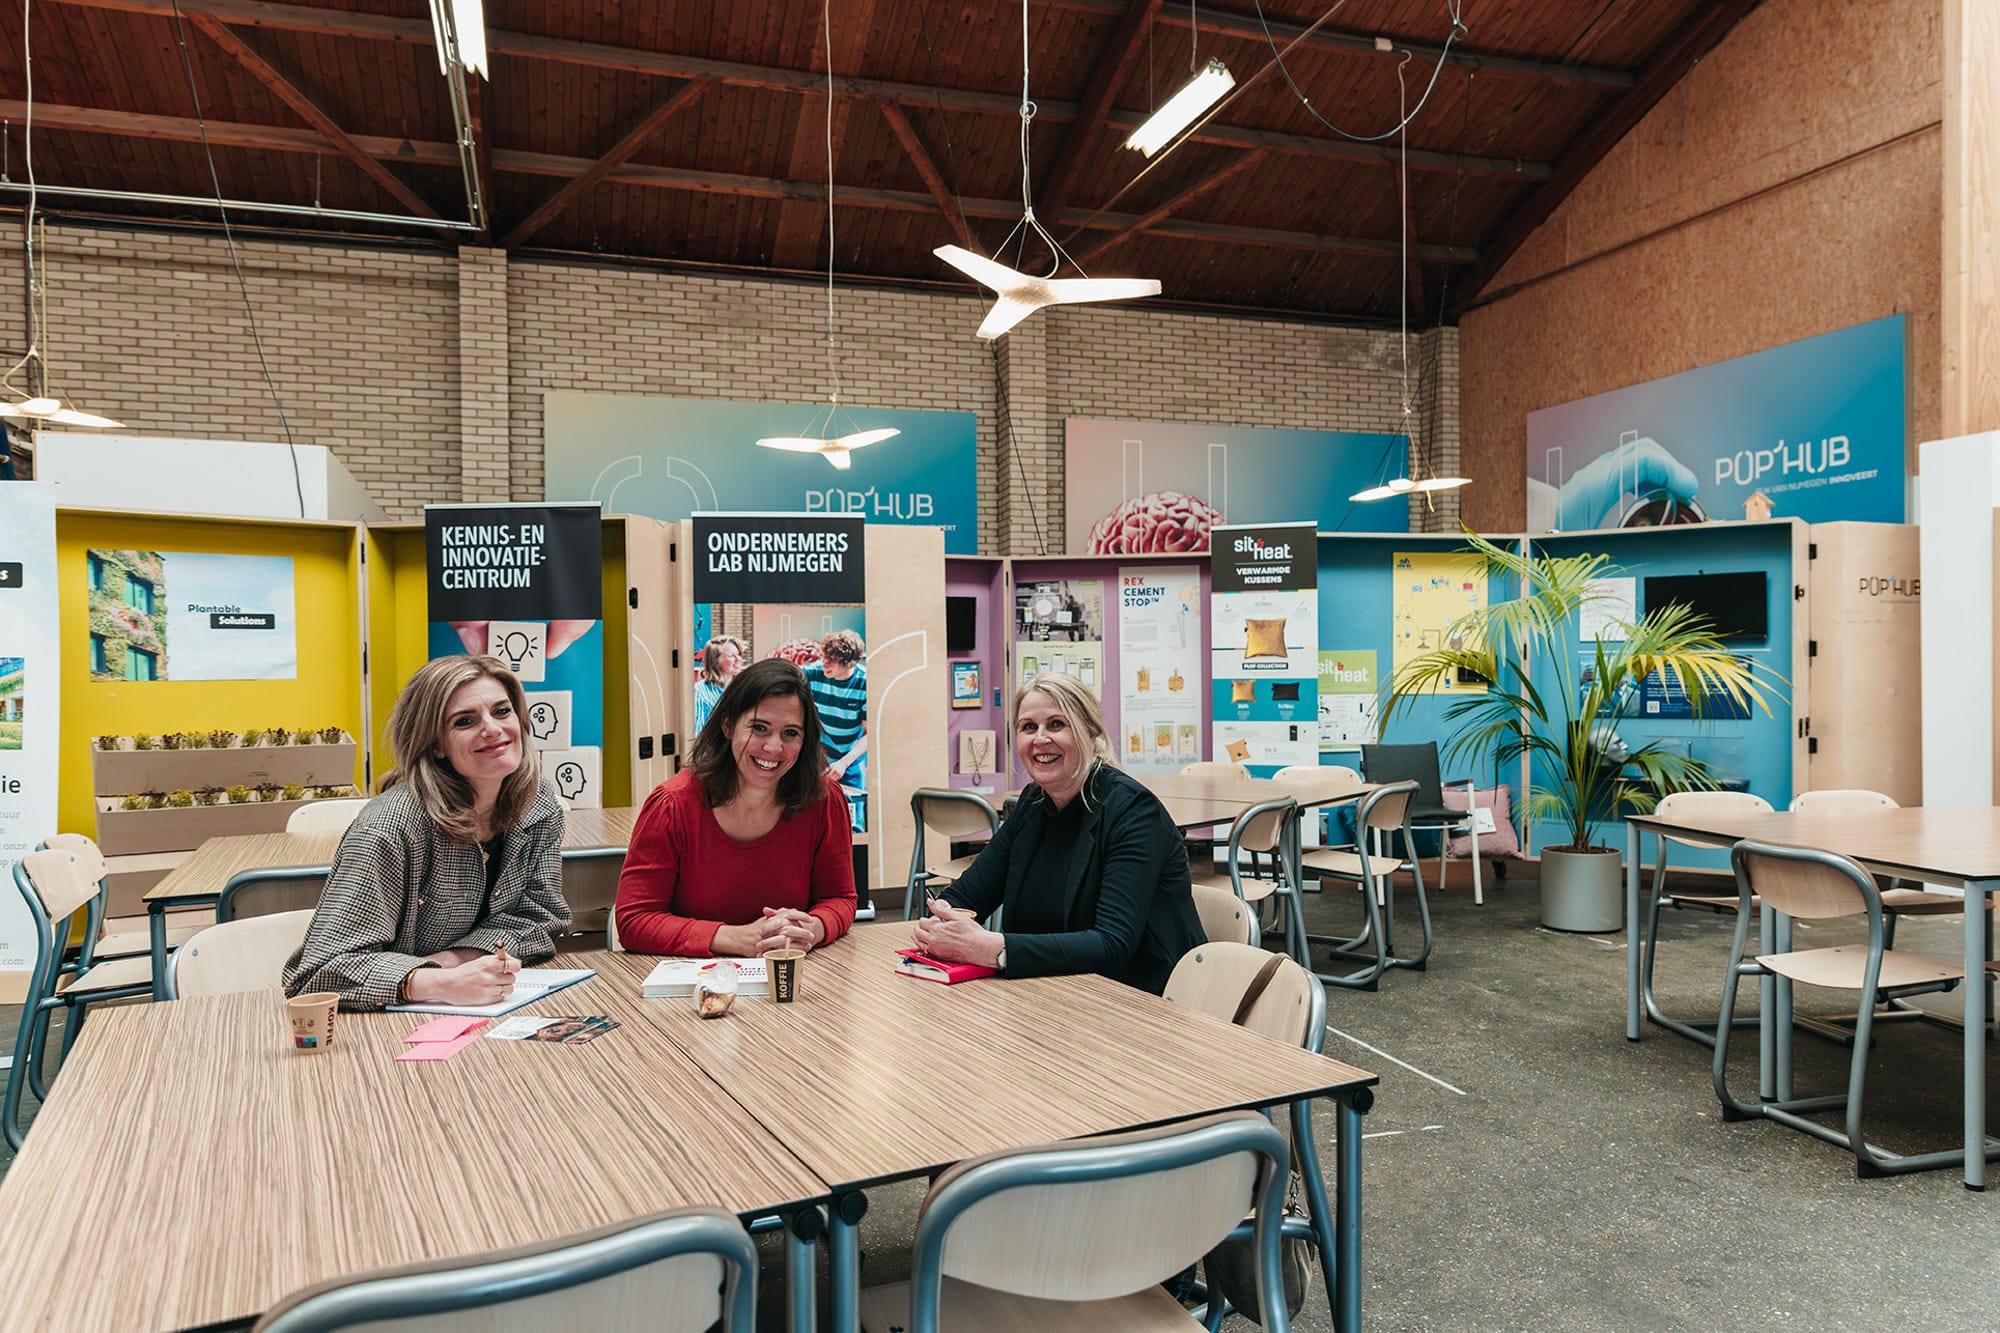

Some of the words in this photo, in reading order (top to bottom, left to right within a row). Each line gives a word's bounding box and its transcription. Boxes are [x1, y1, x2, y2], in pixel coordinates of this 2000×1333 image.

[1715, 435, 1850, 486] POP'HUB
[1788, 478, 1828, 491] NIJMEGEN
[1829, 469, 1879, 485] INNOVEERT
[805, 486, 934, 519] POP'HUB
[441, 525, 516, 546] KENNIS-
[520, 524, 545, 544] EN
[707, 532, 848, 553] ONDERNEMERS
[442, 546, 546, 567] INNOVATIE-
[708, 554, 743, 573] LAB
[748, 553, 843, 573] NIJMEGEN
[442, 568, 531, 589] CENTRUM
[1123, 577, 1144, 586] REX
[1236, 566, 1291, 576] VERWARMDE
[1244, 576, 1282, 585] KUSSENS
[1123, 587, 1165, 596] CEMENT
[1859, 576, 1920, 597] POP'HUB
[188, 603, 241, 613] Plantable
[218, 615, 266, 626] Solutions
[779, 963, 788, 998] KOFFIE
[326, 1006, 335, 1046] KOFFIE
